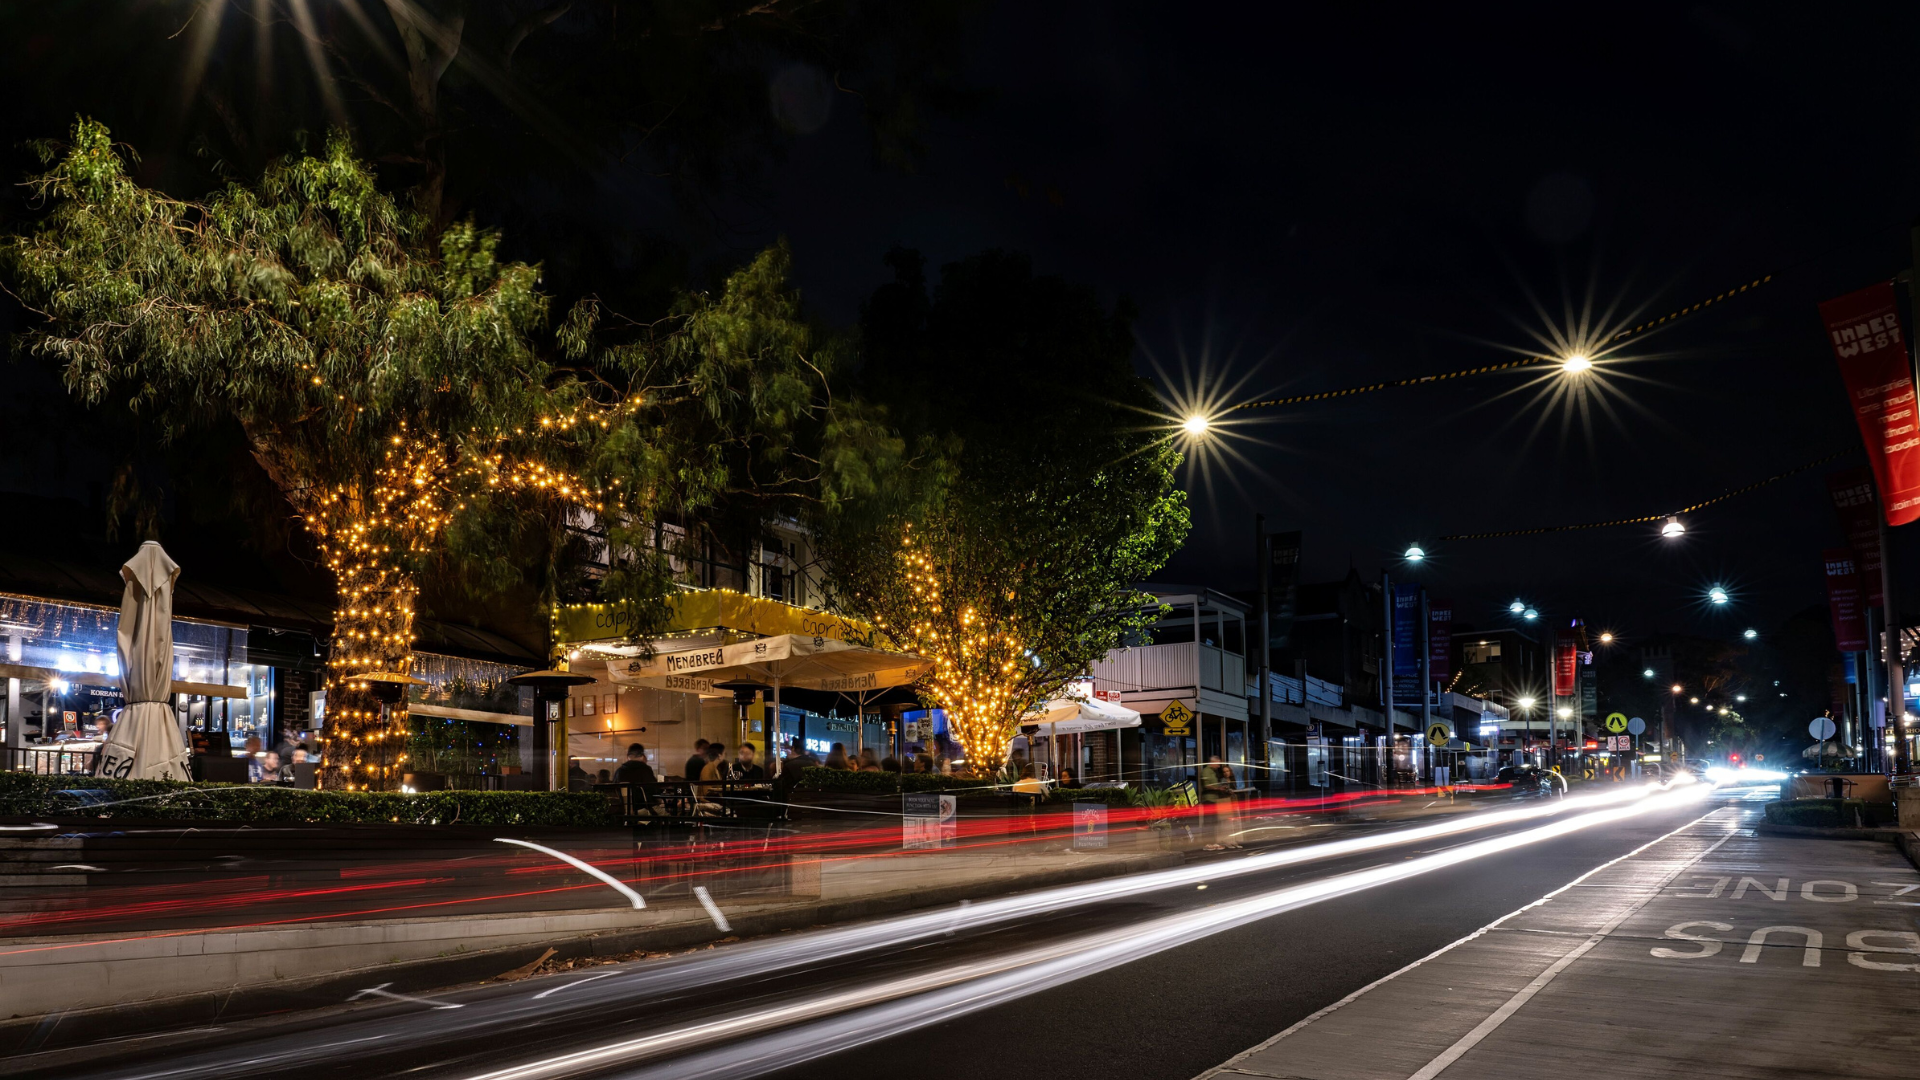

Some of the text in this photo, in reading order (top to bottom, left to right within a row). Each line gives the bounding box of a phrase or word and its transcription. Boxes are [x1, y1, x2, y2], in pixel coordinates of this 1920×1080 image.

[1832, 313, 1898, 345] INNER
[1837, 327, 1901, 359] WEST
[1856, 377, 1911, 399] Libraries
[1832, 483, 1871, 500] INNER
[1834, 492, 1873, 509] WEST
[1825, 559, 1856, 570] INNER
[1826, 566, 1856, 577] WEST
[1431, 609, 1453, 617] INNER
[1431, 614, 1453, 622] WEST
[667, 649, 724, 671] MENABREA
[90, 689, 118, 698] KOREAN
[1675, 875, 1920, 907] ZONE
[1650, 920, 1920, 973] BUS
